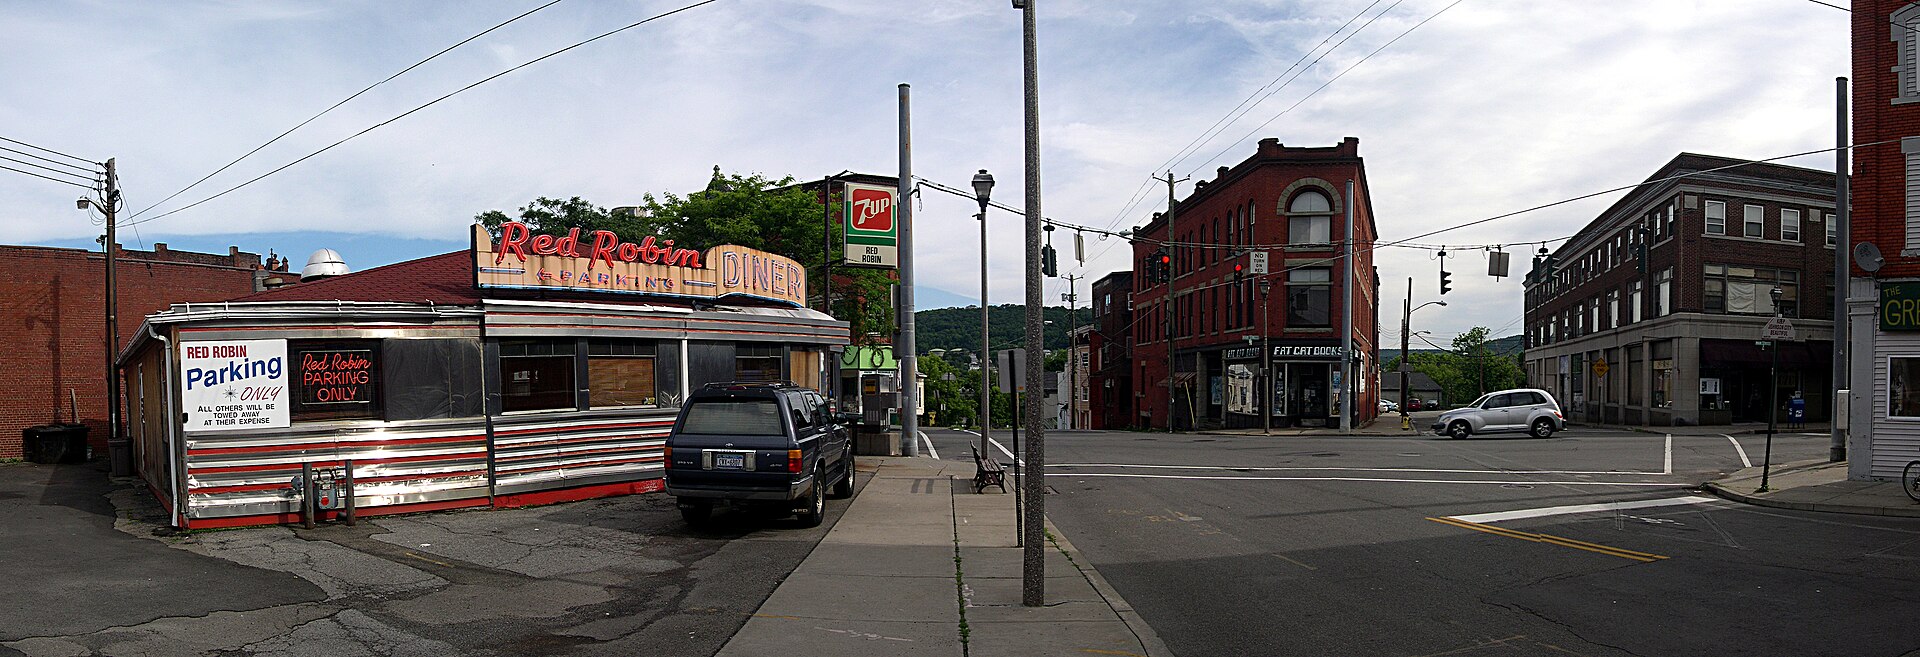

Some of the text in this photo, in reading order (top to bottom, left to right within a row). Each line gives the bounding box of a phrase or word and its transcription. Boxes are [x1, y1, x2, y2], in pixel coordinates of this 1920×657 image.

[495, 221, 702, 271] Red Robin
[865, 246, 878, 254] RED
[862, 255, 882, 263] ROBIN
[560, 269, 675, 289] PARKING
[722, 251, 801, 300] DINER
[1884, 286, 1901, 297] THE
[187, 345, 247, 359] RED ROBIN
[1273, 346, 1342, 355] FAT CAT BOOKS
[301, 353, 371, 371] Red Robin
[187, 356, 282, 390] Parking
[304, 370, 369, 386] PARKING
[240, 386, 283, 401] ONLY
[317, 386, 357, 402] ONLY
[198, 405, 213, 413] ALL
[215, 404, 243, 412] OTHERS
[246, 403, 263, 411] WILL
